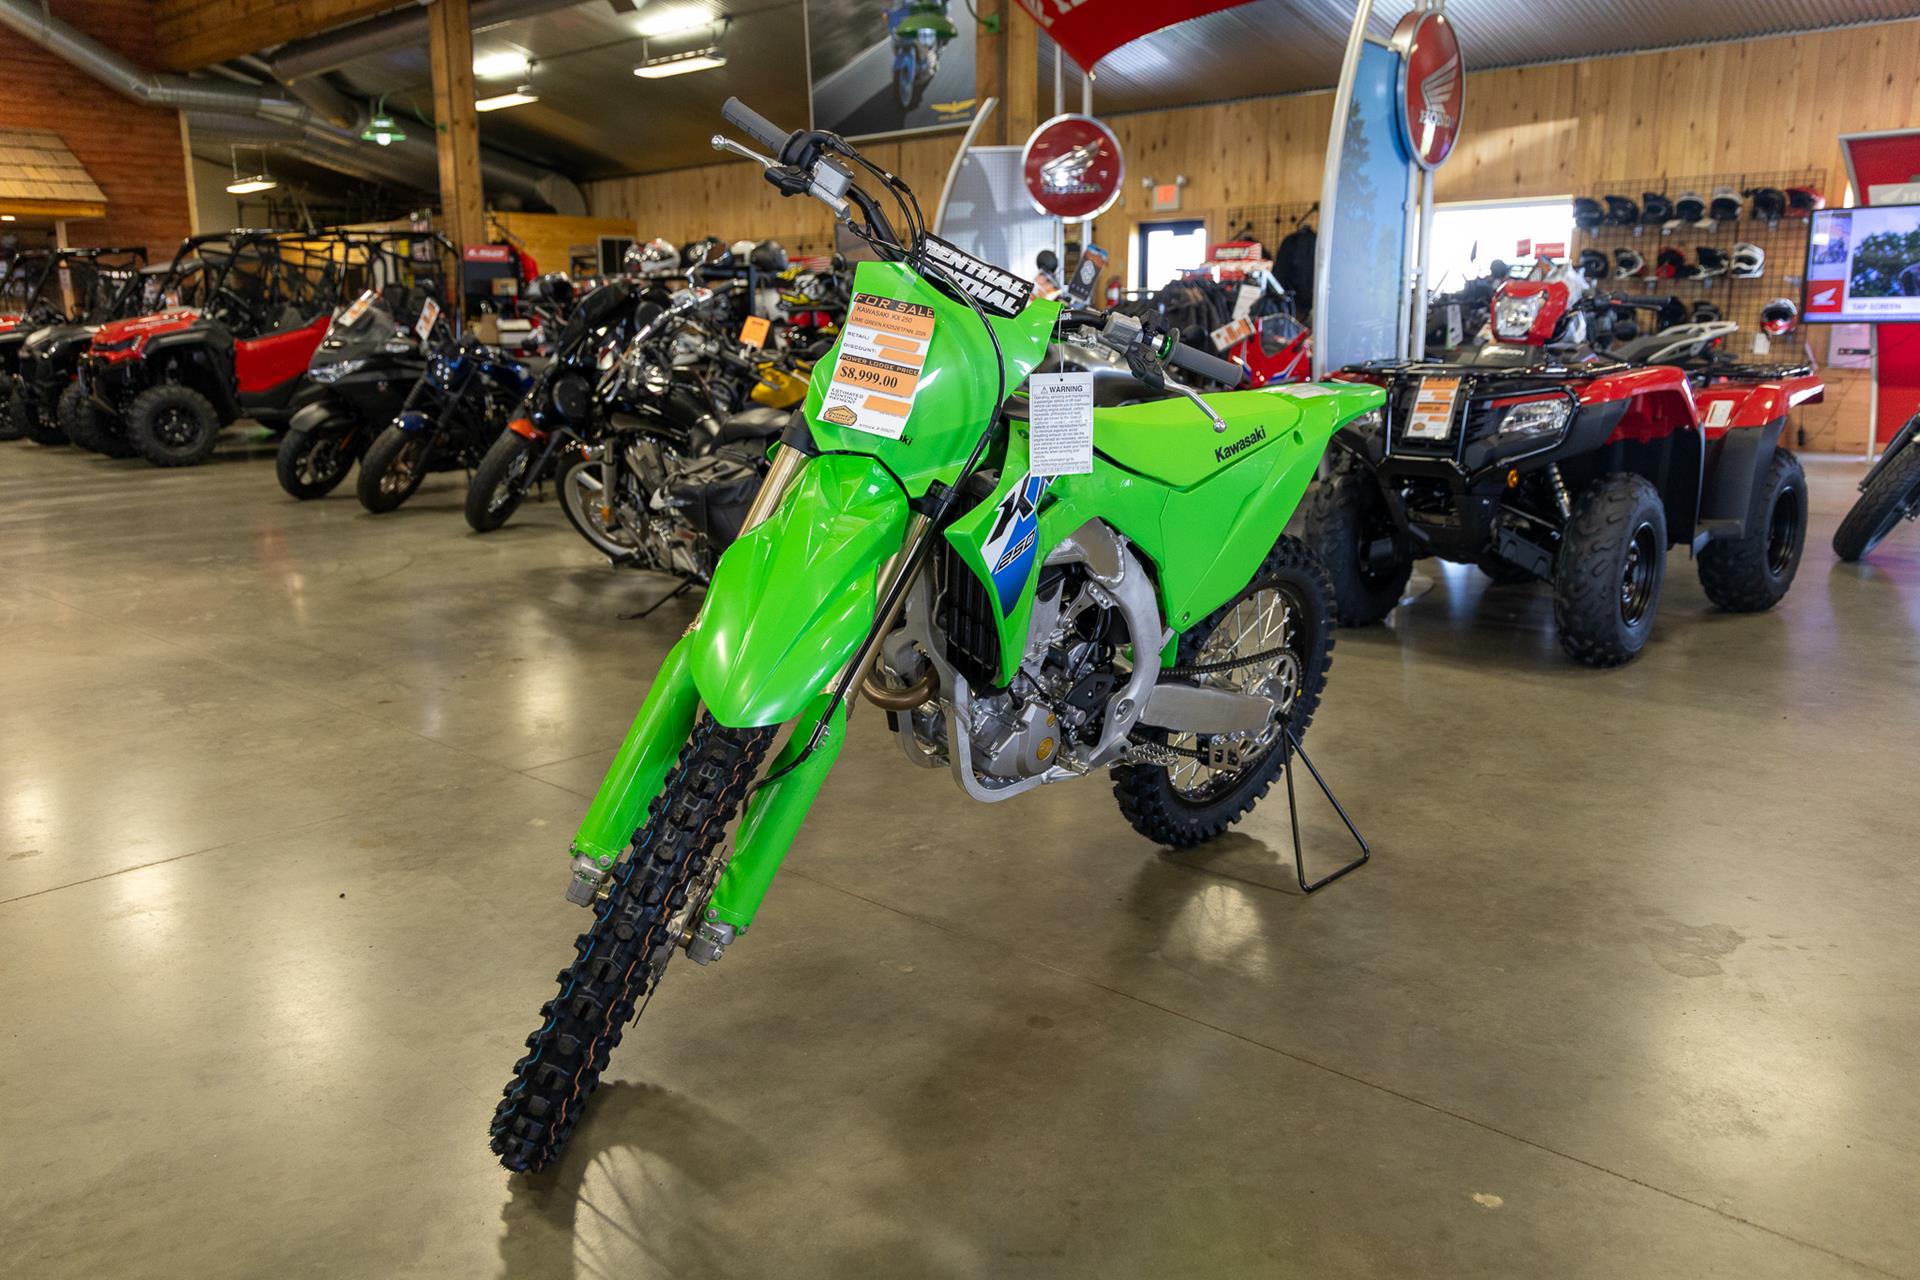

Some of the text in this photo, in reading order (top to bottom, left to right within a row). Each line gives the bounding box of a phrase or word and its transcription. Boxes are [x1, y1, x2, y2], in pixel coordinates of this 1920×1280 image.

[924, 238, 1025, 298] RENTHAL
[855, 294, 934, 318] FOR SALE
[856, 306, 890, 318] KAWASAKI
[864, 319, 882, 327] GREEN
[841, 354, 919, 376] POWER LODGE PRICE
[1049, 385, 1083, 393] WARNING
[1214, 425, 1266, 463] Kawasaki
[996, 528, 1037, 573] 250
